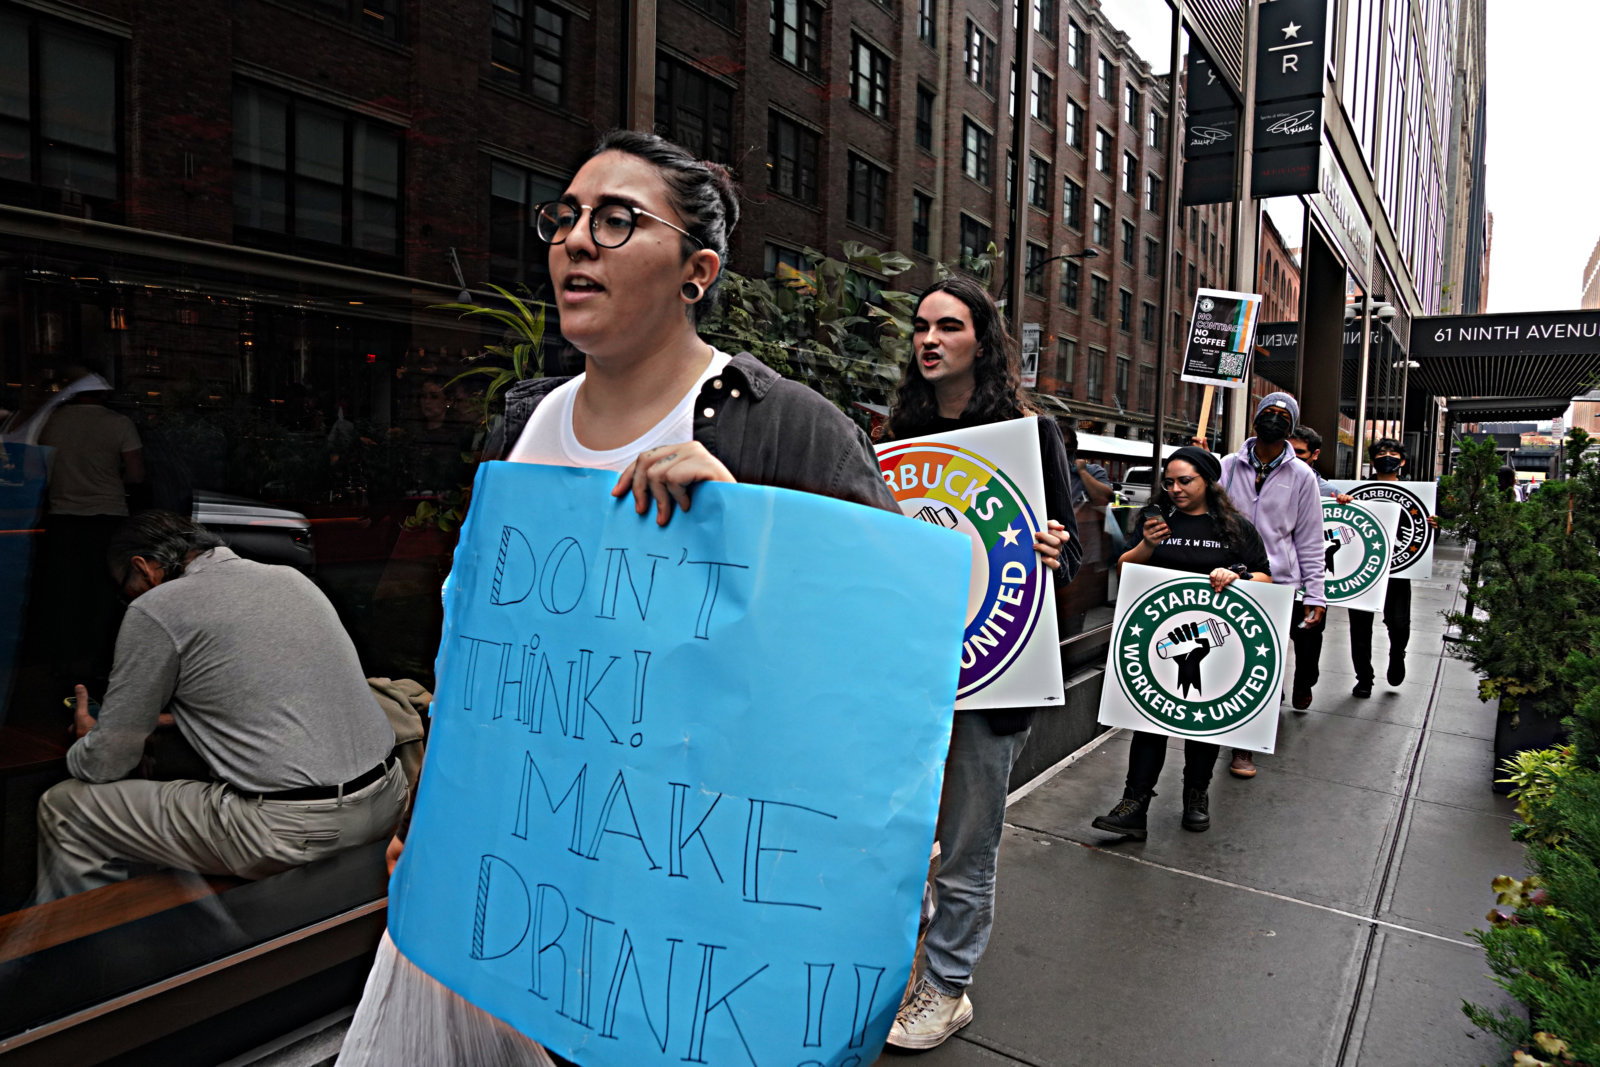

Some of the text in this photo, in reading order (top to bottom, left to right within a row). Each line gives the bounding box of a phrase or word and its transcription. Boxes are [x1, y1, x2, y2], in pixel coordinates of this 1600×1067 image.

[1282, 54, 1298, 74] R
[1194, 328, 1209, 336] NO
[1197, 312, 1212, 321] NO
[1434, 322, 1600, 342] 61 NINTH AVENU
[1193, 336, 1227, 347] COFFEE
[882, 463, 1004, 521] RBUCKS
[1355, 490, 1412, 508] TARBUCKS
[1323, 507, 1378, 539] RBUCKS
[1166, 538, 1182, 546] AVE
[1185, 539, 1191, 547] X
[1202, 540, 1221, 549] 15TH
[1392, 552, 1410, 565] TED
[490, 525, 749, 639] DON'T
[1339, 555, 1380, 592] UNITED
[960, 561, 1027, 669] UNITED
[1144, 589, 1262, 639] STARBUCKS
[1124, 643, 1187, 721] WORKERS
[1208, 664, 1268, 721] UNITED
[511, 750, 838, 910] MAKE
